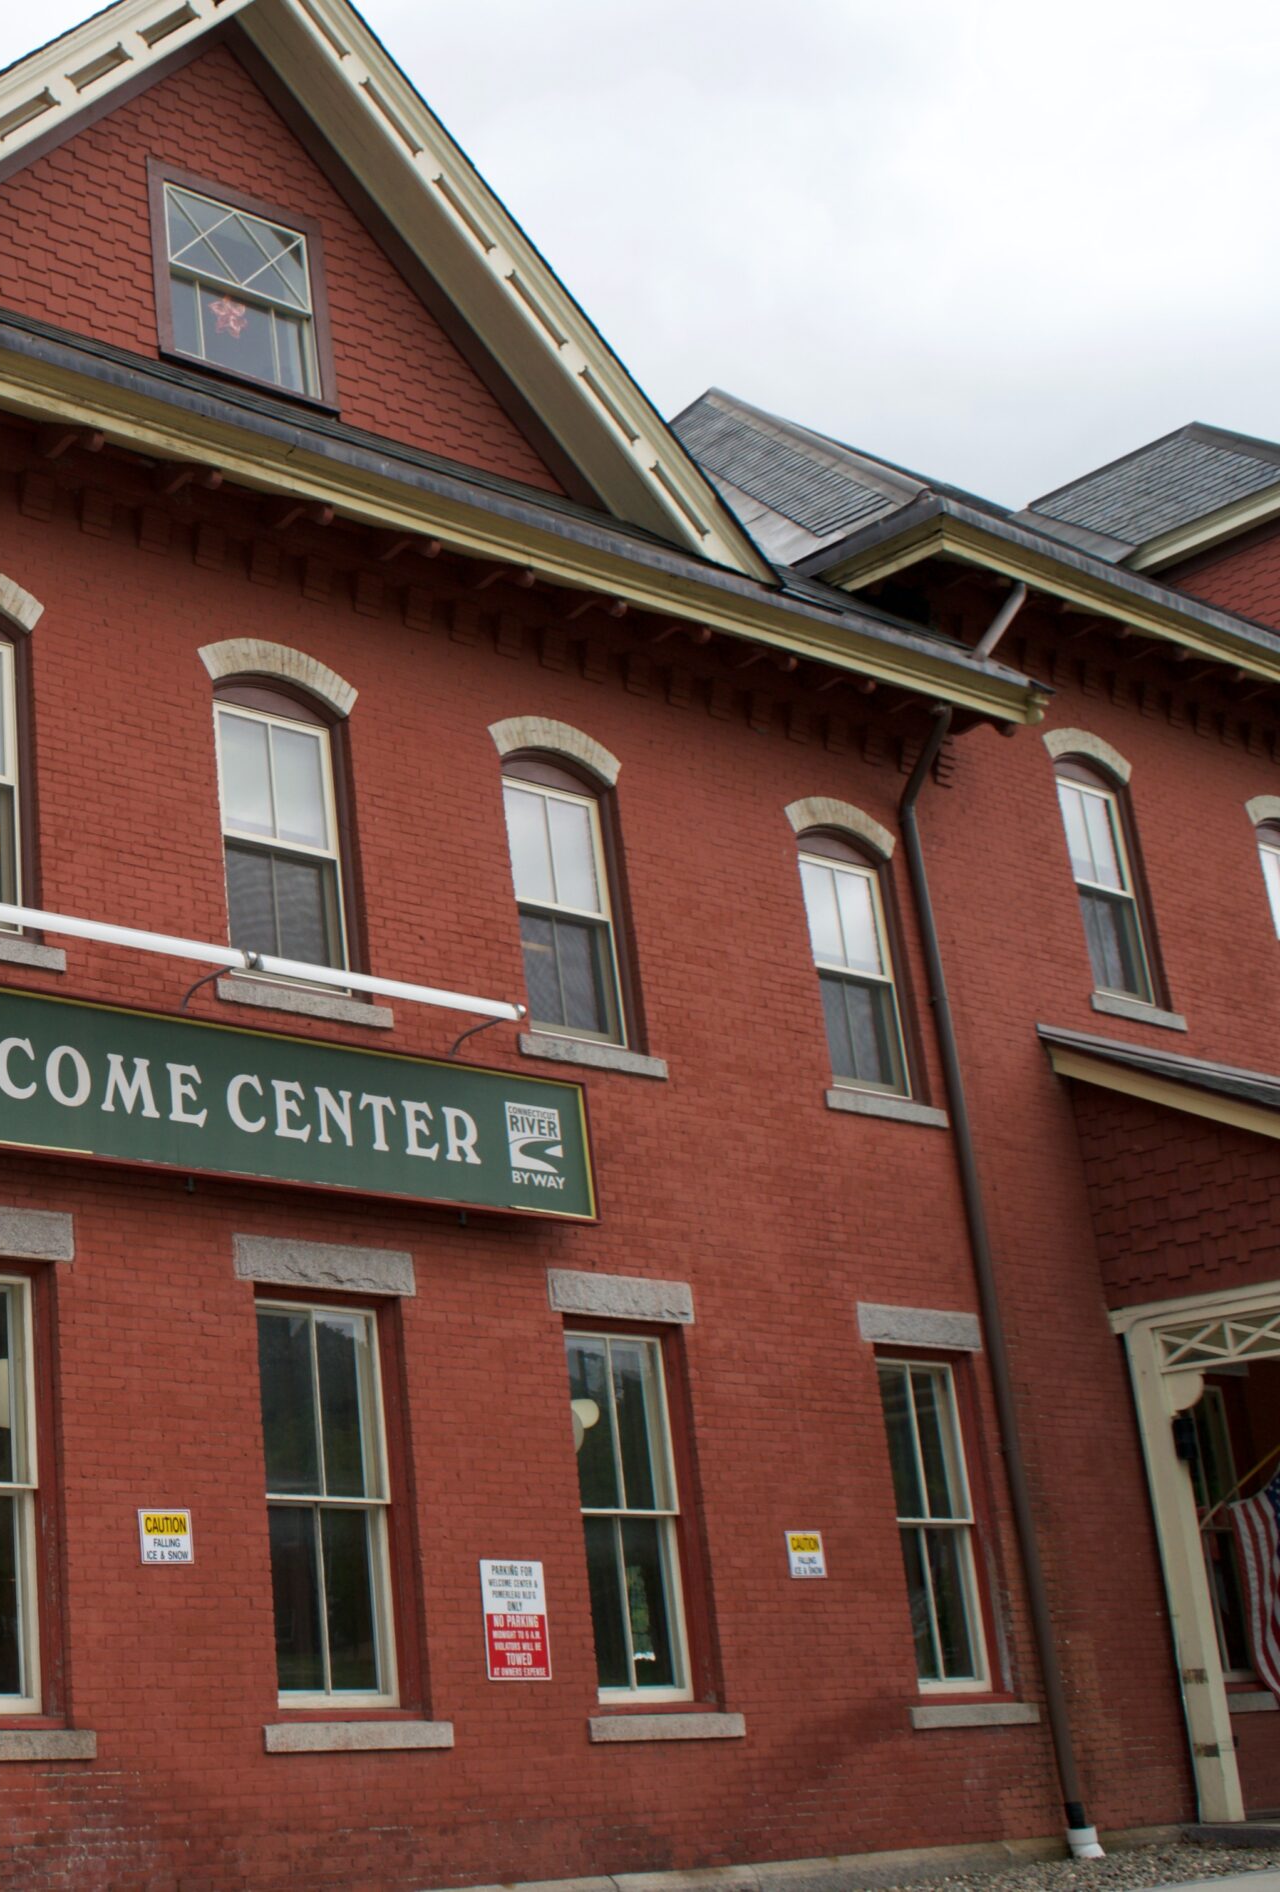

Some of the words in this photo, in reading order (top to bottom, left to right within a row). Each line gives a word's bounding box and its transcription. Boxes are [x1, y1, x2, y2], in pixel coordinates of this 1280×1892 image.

[226, 1074, 482, 1165] CENTER
[508, 1106, 556, 1120] CONNECTICUT
[509, 1114, 558, 1138] RIVER
[512, 1170, 566, 1190] BYWAY
[145, 1516, 187, 1533] CAUTION
[153, 1538, 181, 1548] FALLING
[791, 1536, 820, 1551] CAUTION
[146, 1550, 158, 1560] ICE
[161, 1551, 165, 1560] &
[167, 1550, 189, 1560] SNOW
[491, 1564, 519, 1576] PARKING
[520, 1565, 533, 1577] FOR
[488, 1579, 512, 1588] WELCOME
[513, 1579, 533, 1588] CENTER
[507, 1601, 523, 1612] ONLY
[493, 1614, 505, 1628] NO
[506, 1614, 539, 1628] PARKING
[492, 1630, 517, 1640] MIDNIGHT
[494, 1641, 521, 1651] VIOLATORS
[521, 1641, 534, 1651] WILL
[535, 1642, 542, 1651] BE
[505, 1652, 533, 1666] TOWED
[494, 1667, 500, 1676] AT
[501, 1667, 523, 1677] OWNERS
[523, 1667, 547, 1677] EXPENSE
